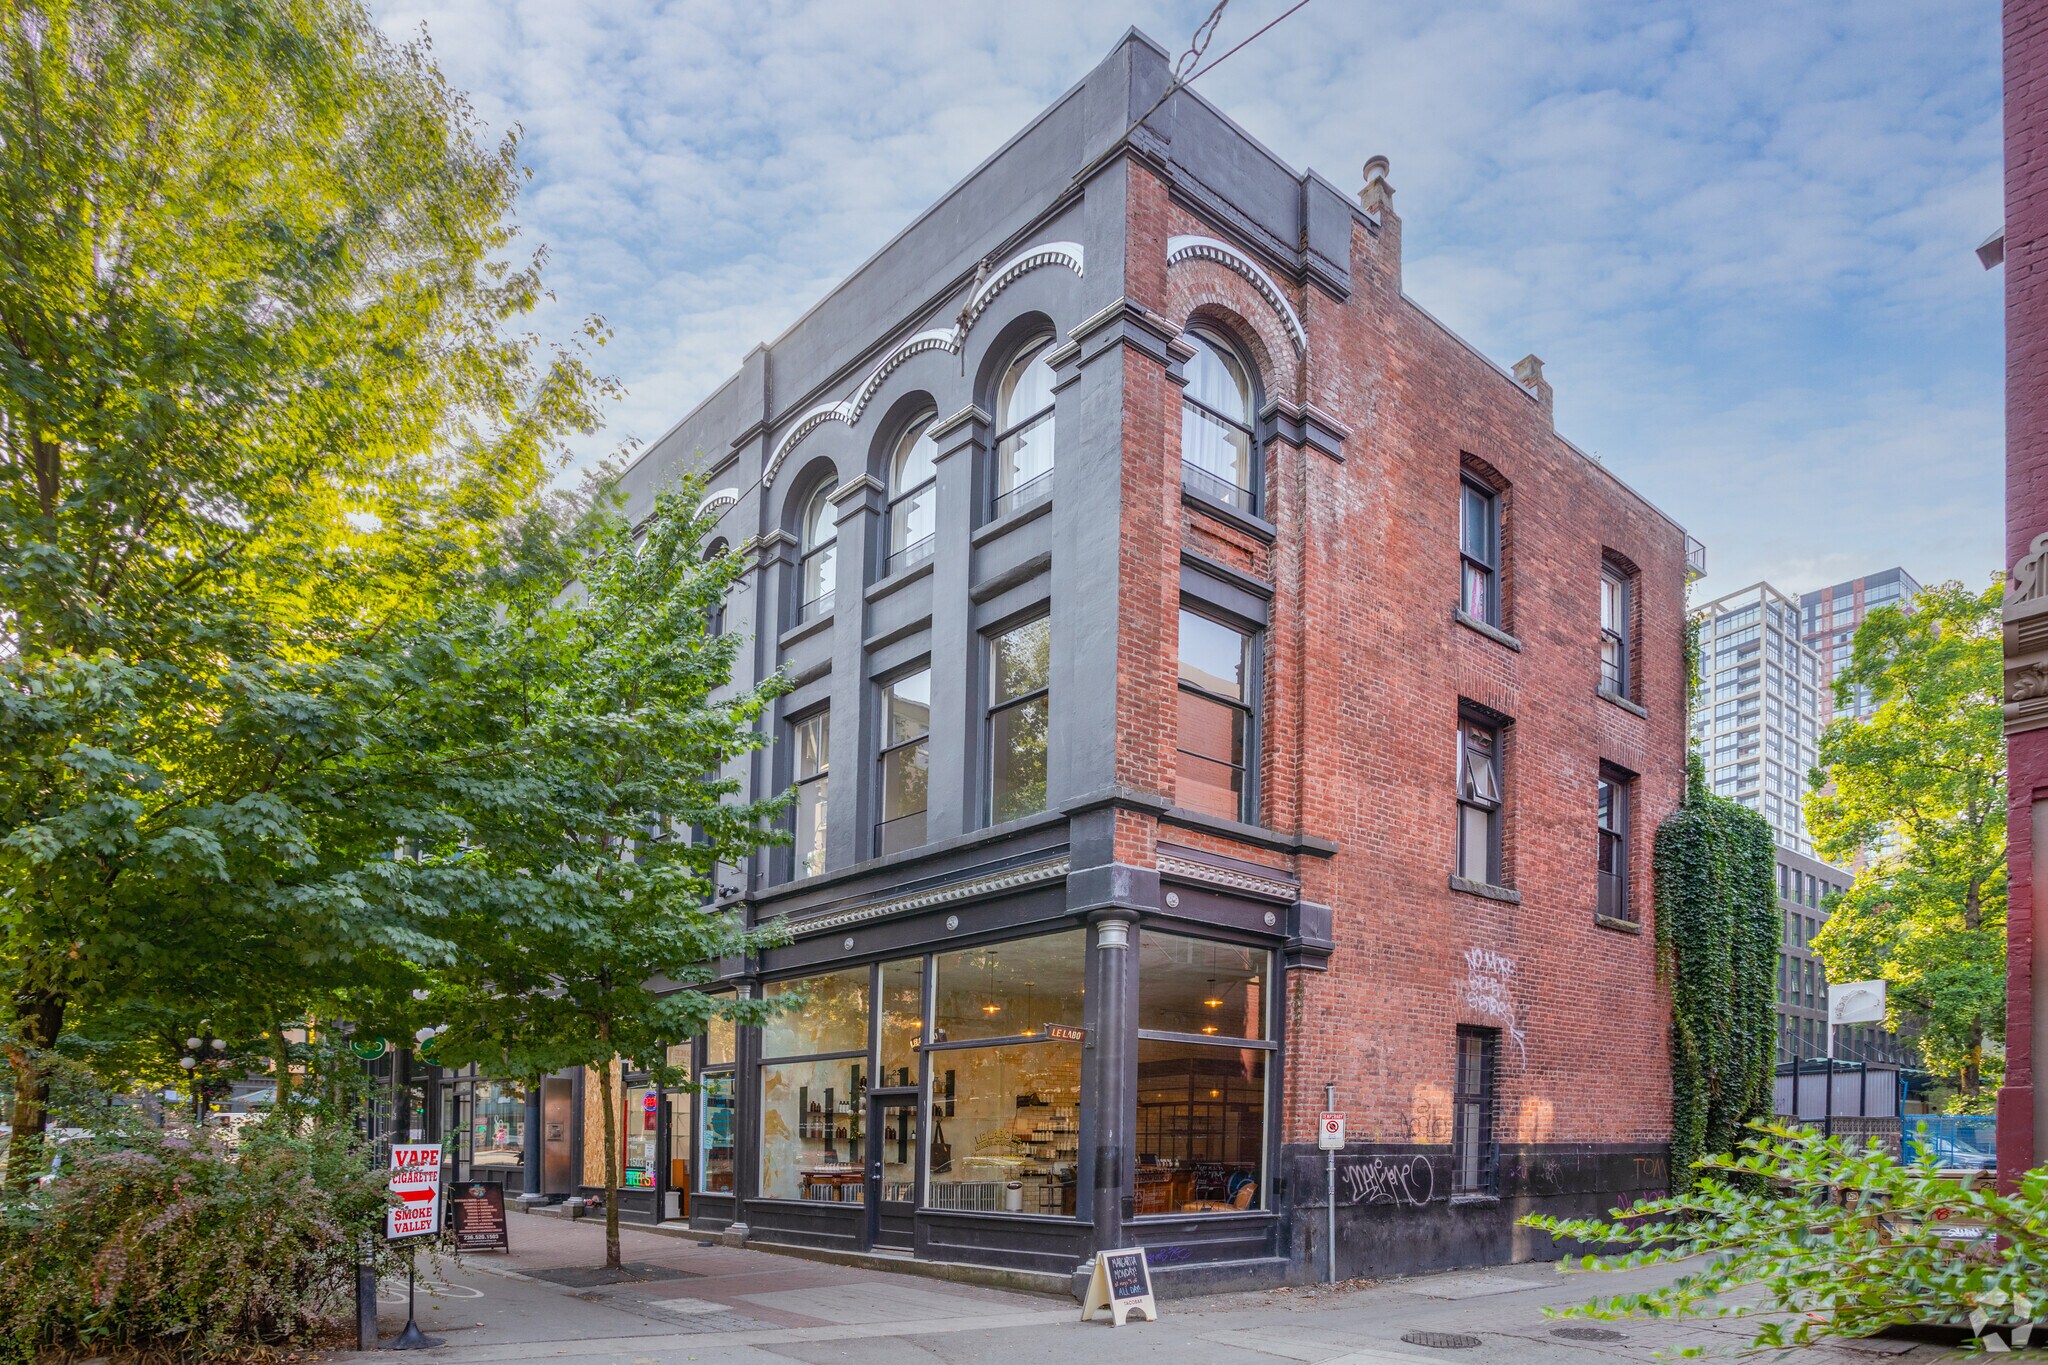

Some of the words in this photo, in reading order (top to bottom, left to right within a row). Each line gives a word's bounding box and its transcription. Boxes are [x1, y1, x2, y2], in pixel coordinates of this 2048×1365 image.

[1052, 1028, 1062, 1038] LE
[1062, 1029, 1082, 1040] LABO
[975, 1133, 987, 1144] LE
[988, 1128, 1010, 1141] LABO
[395, 1149, 439, 1167] VAPE
[392, 1170, 438, 1184] CIGARETTE
[1633, 1158, 1669, 1182] TOM
[394, 1207, 433, 1221] SMOKE
[394, 1219, 432, 1233] VALLEY
[1118, 1287, 1130, 1296] ALL
